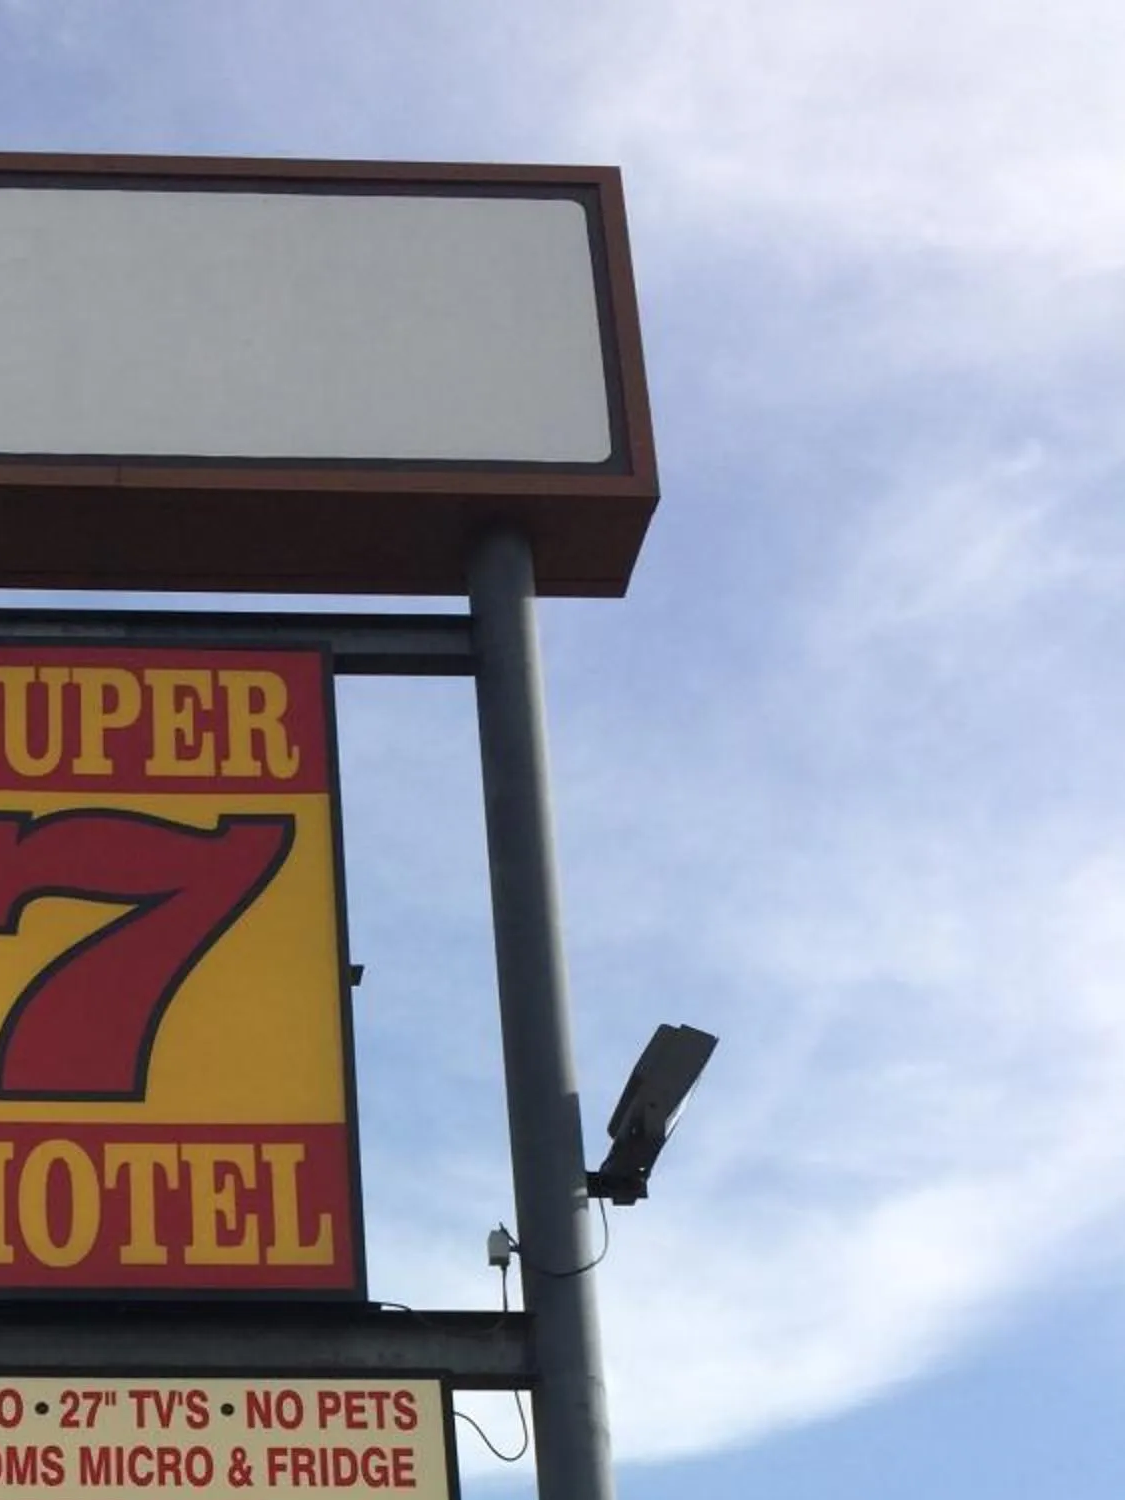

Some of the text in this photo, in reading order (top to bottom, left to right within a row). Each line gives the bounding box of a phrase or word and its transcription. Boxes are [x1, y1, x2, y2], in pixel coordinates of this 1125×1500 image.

[58, 1389, 117, 1429] 27"
[128, 1389, 210, 1430] TV'S
[246, 1389, 304, 1431] NO
[318, 1390, 418, 1431] PETS
[79, 1445, 214, 1488] MICRO
[228, 1446, 254, 1489] &
[267, 1447, 417, 1488] FRIDGE
